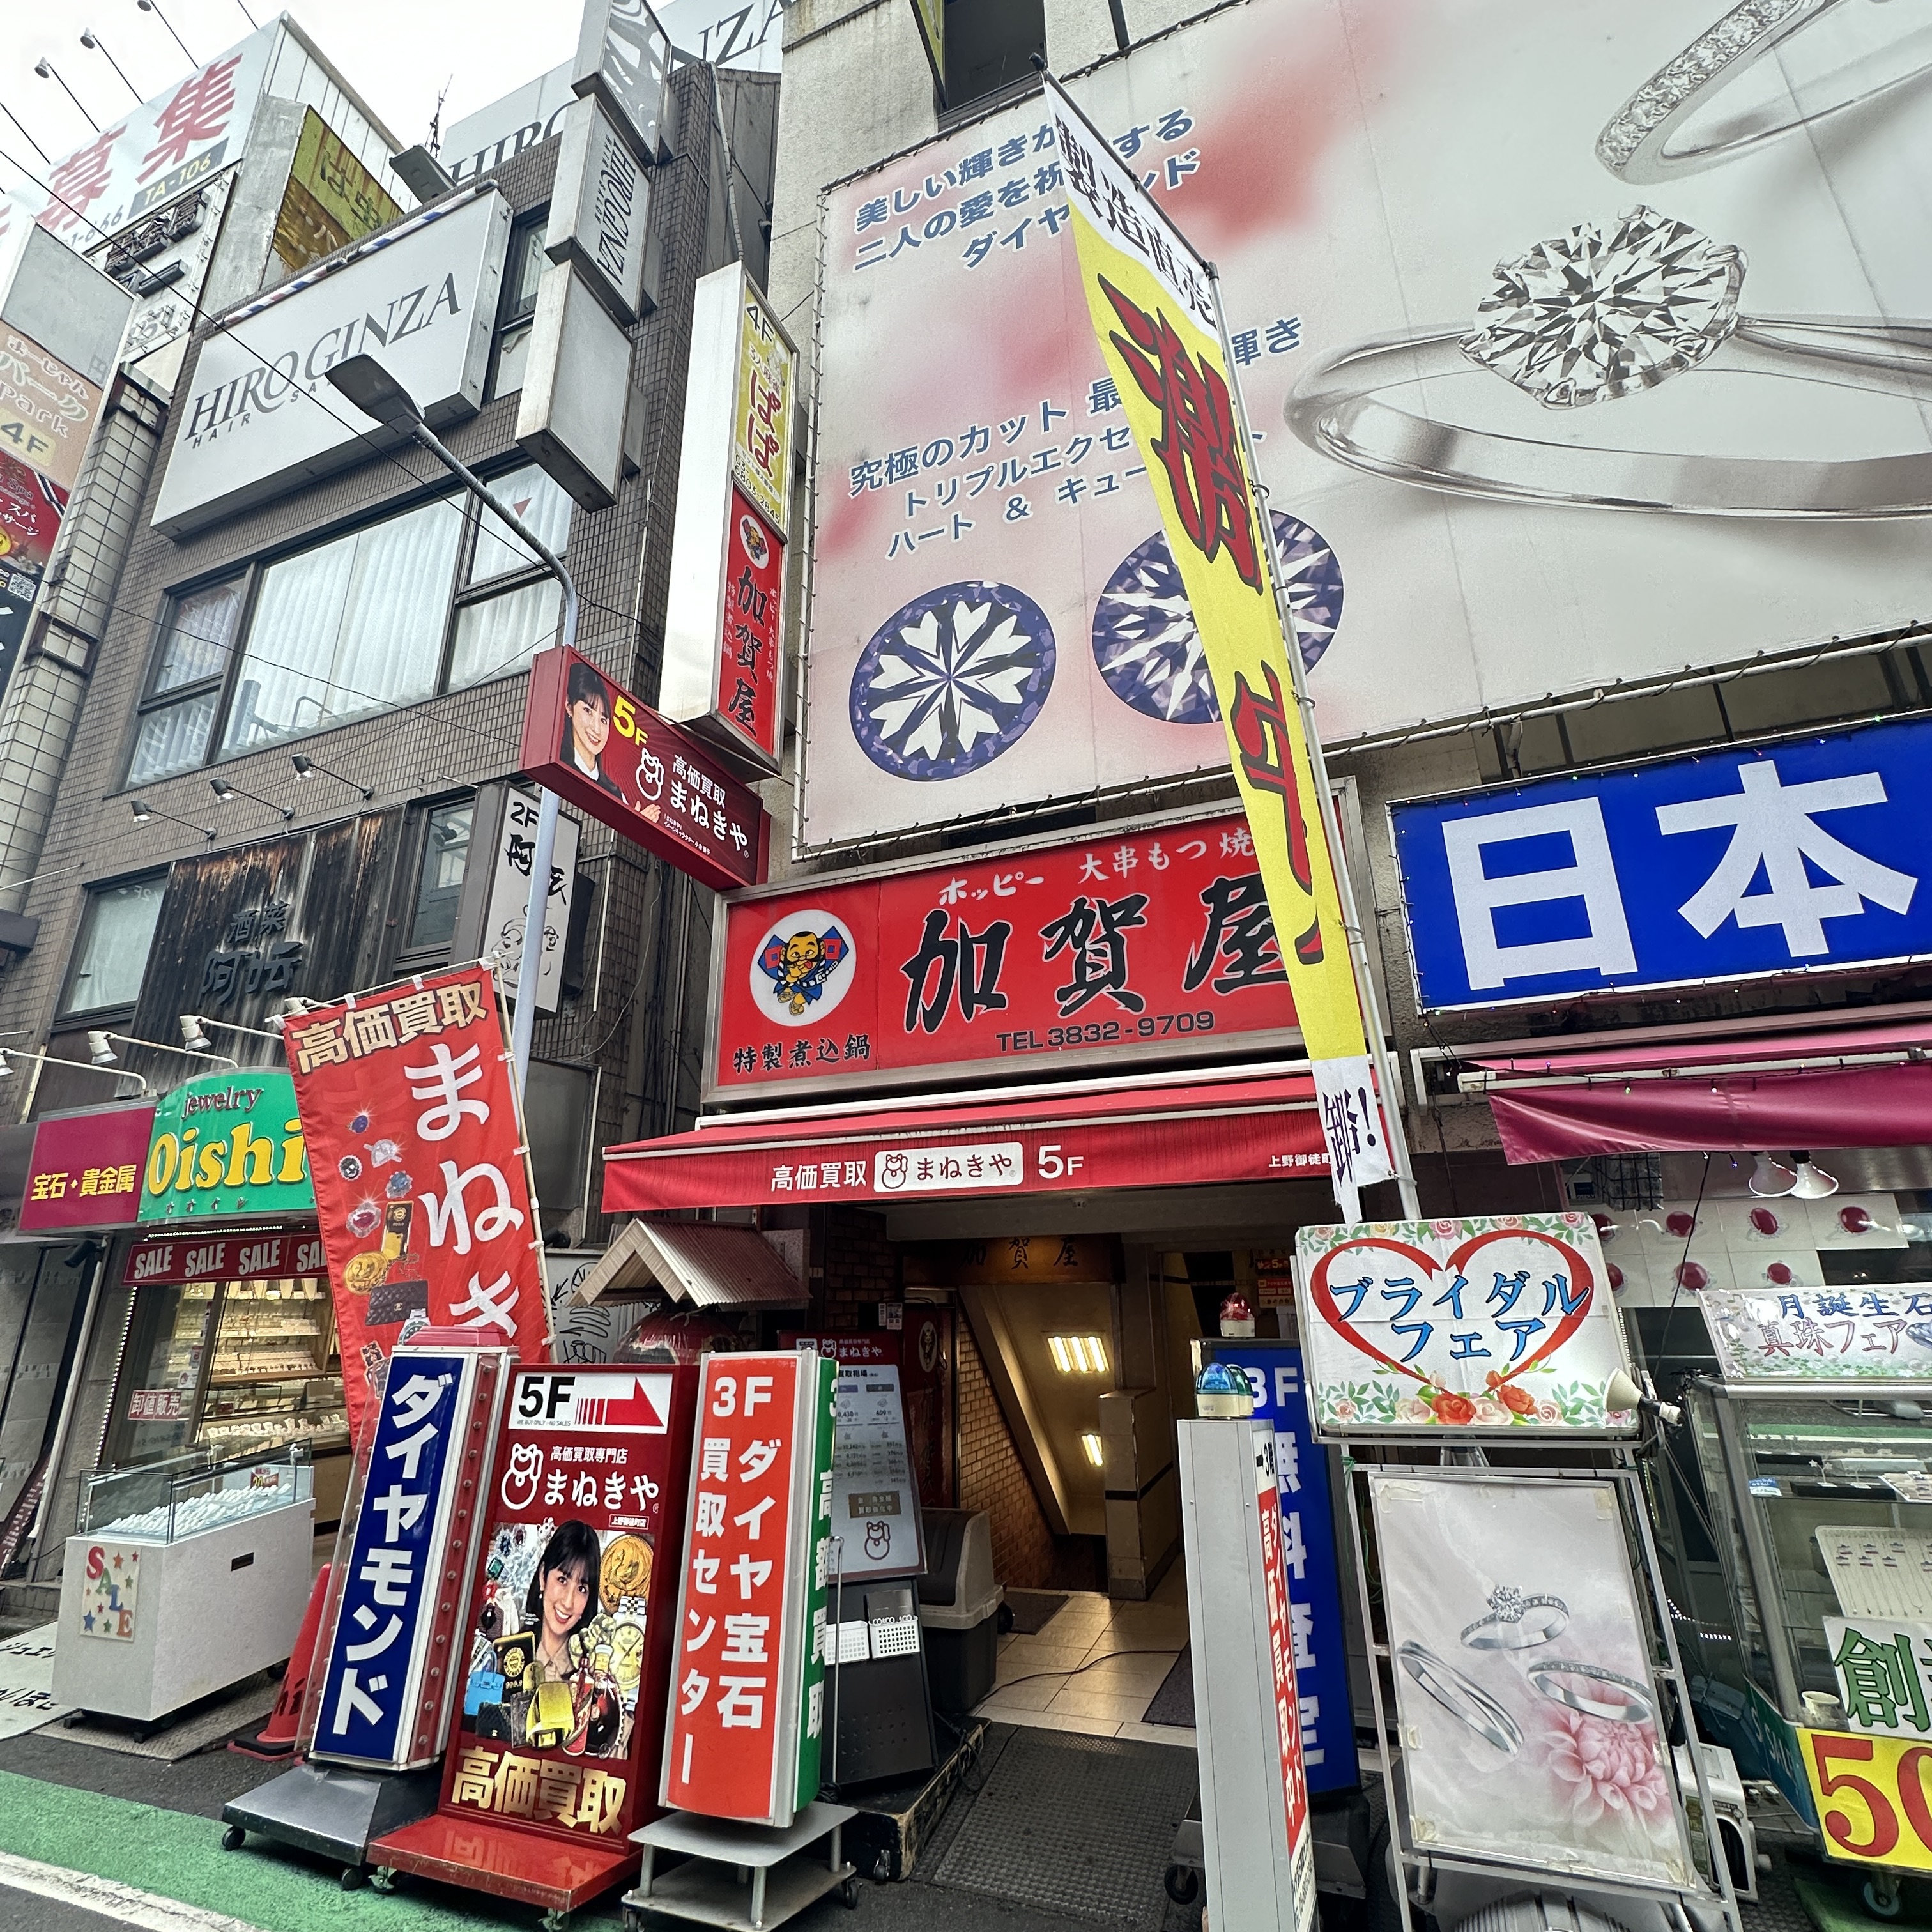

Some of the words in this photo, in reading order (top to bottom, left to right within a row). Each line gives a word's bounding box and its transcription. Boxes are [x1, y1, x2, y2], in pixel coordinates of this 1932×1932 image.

[0, 53, 243, 235] 募集
[144, 153, 211, 206] TA-106
[746, 305, 774, 342] 4F
[184, 351, 299, 441] HIRO
[305, 272, 462, 381] GINZA
[0, 351, 89, 422] パーク
[1, 422, 49, 454] 4F
[192, 412, 251, 448] HAIR
[748, 369, 781, 477] ぱぱ
[849, 398, 1068, 495] 究極のカット
[887, 510, 976, 558] ハート
[1005, 496, 1032, 521] &
[728, 565, 768, 737] 加賀屋
[613, 695, 648, 746] 5F
[672, 754, 726, 809] 高価買取
[511, 801, 539, 828] 2F
[670, 779, 749, 852] まねきや
[939, 870, 1044, 907] ホッピー
[1078, 826, 1255, 882] 大串もつ焼
[1441, 760, 1918, 991] 日本
[227, 900, 291, 943] 酒菜
[901, 873, 1287, 1036] 加賀屋
[291, 981, 489, 1076] 高価買取
[733, 1032, 871, 1075] 特製煮込鍋
[996, 1030, 1044, 1053] TEL
[1047, 1010, 1215, 1047] 3832-9709
[181, 1085, 264, 1119] jewelry
[31, 1165, 137, 1201] 宝石・貴金属
[148, 1118, 305, 1197] Oishi
[770, 1158, 867, 1192] 高価買取
[915, 1154, 1013, 1182] まねきや
[1038, 1144, 1084, 1179] 5F
[134, 1245, 173, 1278] SALE
[185, 1242, 226, 1277] SALE
[238, 1239, 281, 1275] SALE
[296, 1241, 327, 1273] SAL
[1330, 1270, 1590, 1321] ブライダル
[839, 1346, 882, 1358] まねきや
[1392, 1317, 1545, 1363] フェア
[1758, 1317, 1908, 1357] 真珠フェア
[131, 1392, 180, 1416] 卸値販売
[518, 1376, 576, 1419] 5F
[712, 1376, 773, 1417] 3F
[551, 1445, 628, 1464] 高価買取専門店
[544, 1468, 659, 1511] まねきや
[332, 1373, 452, 1736] ダイヤモンド
[86, 1545, 133, 1637] SALE
[716, 1438, 782, 1729] ダイヤ宝石
[681, 1438, 731, 1784] 買取センター
[1834, 1627, 1932, 1732] 創
[451, 1746, 627, 1834] 高価買取
